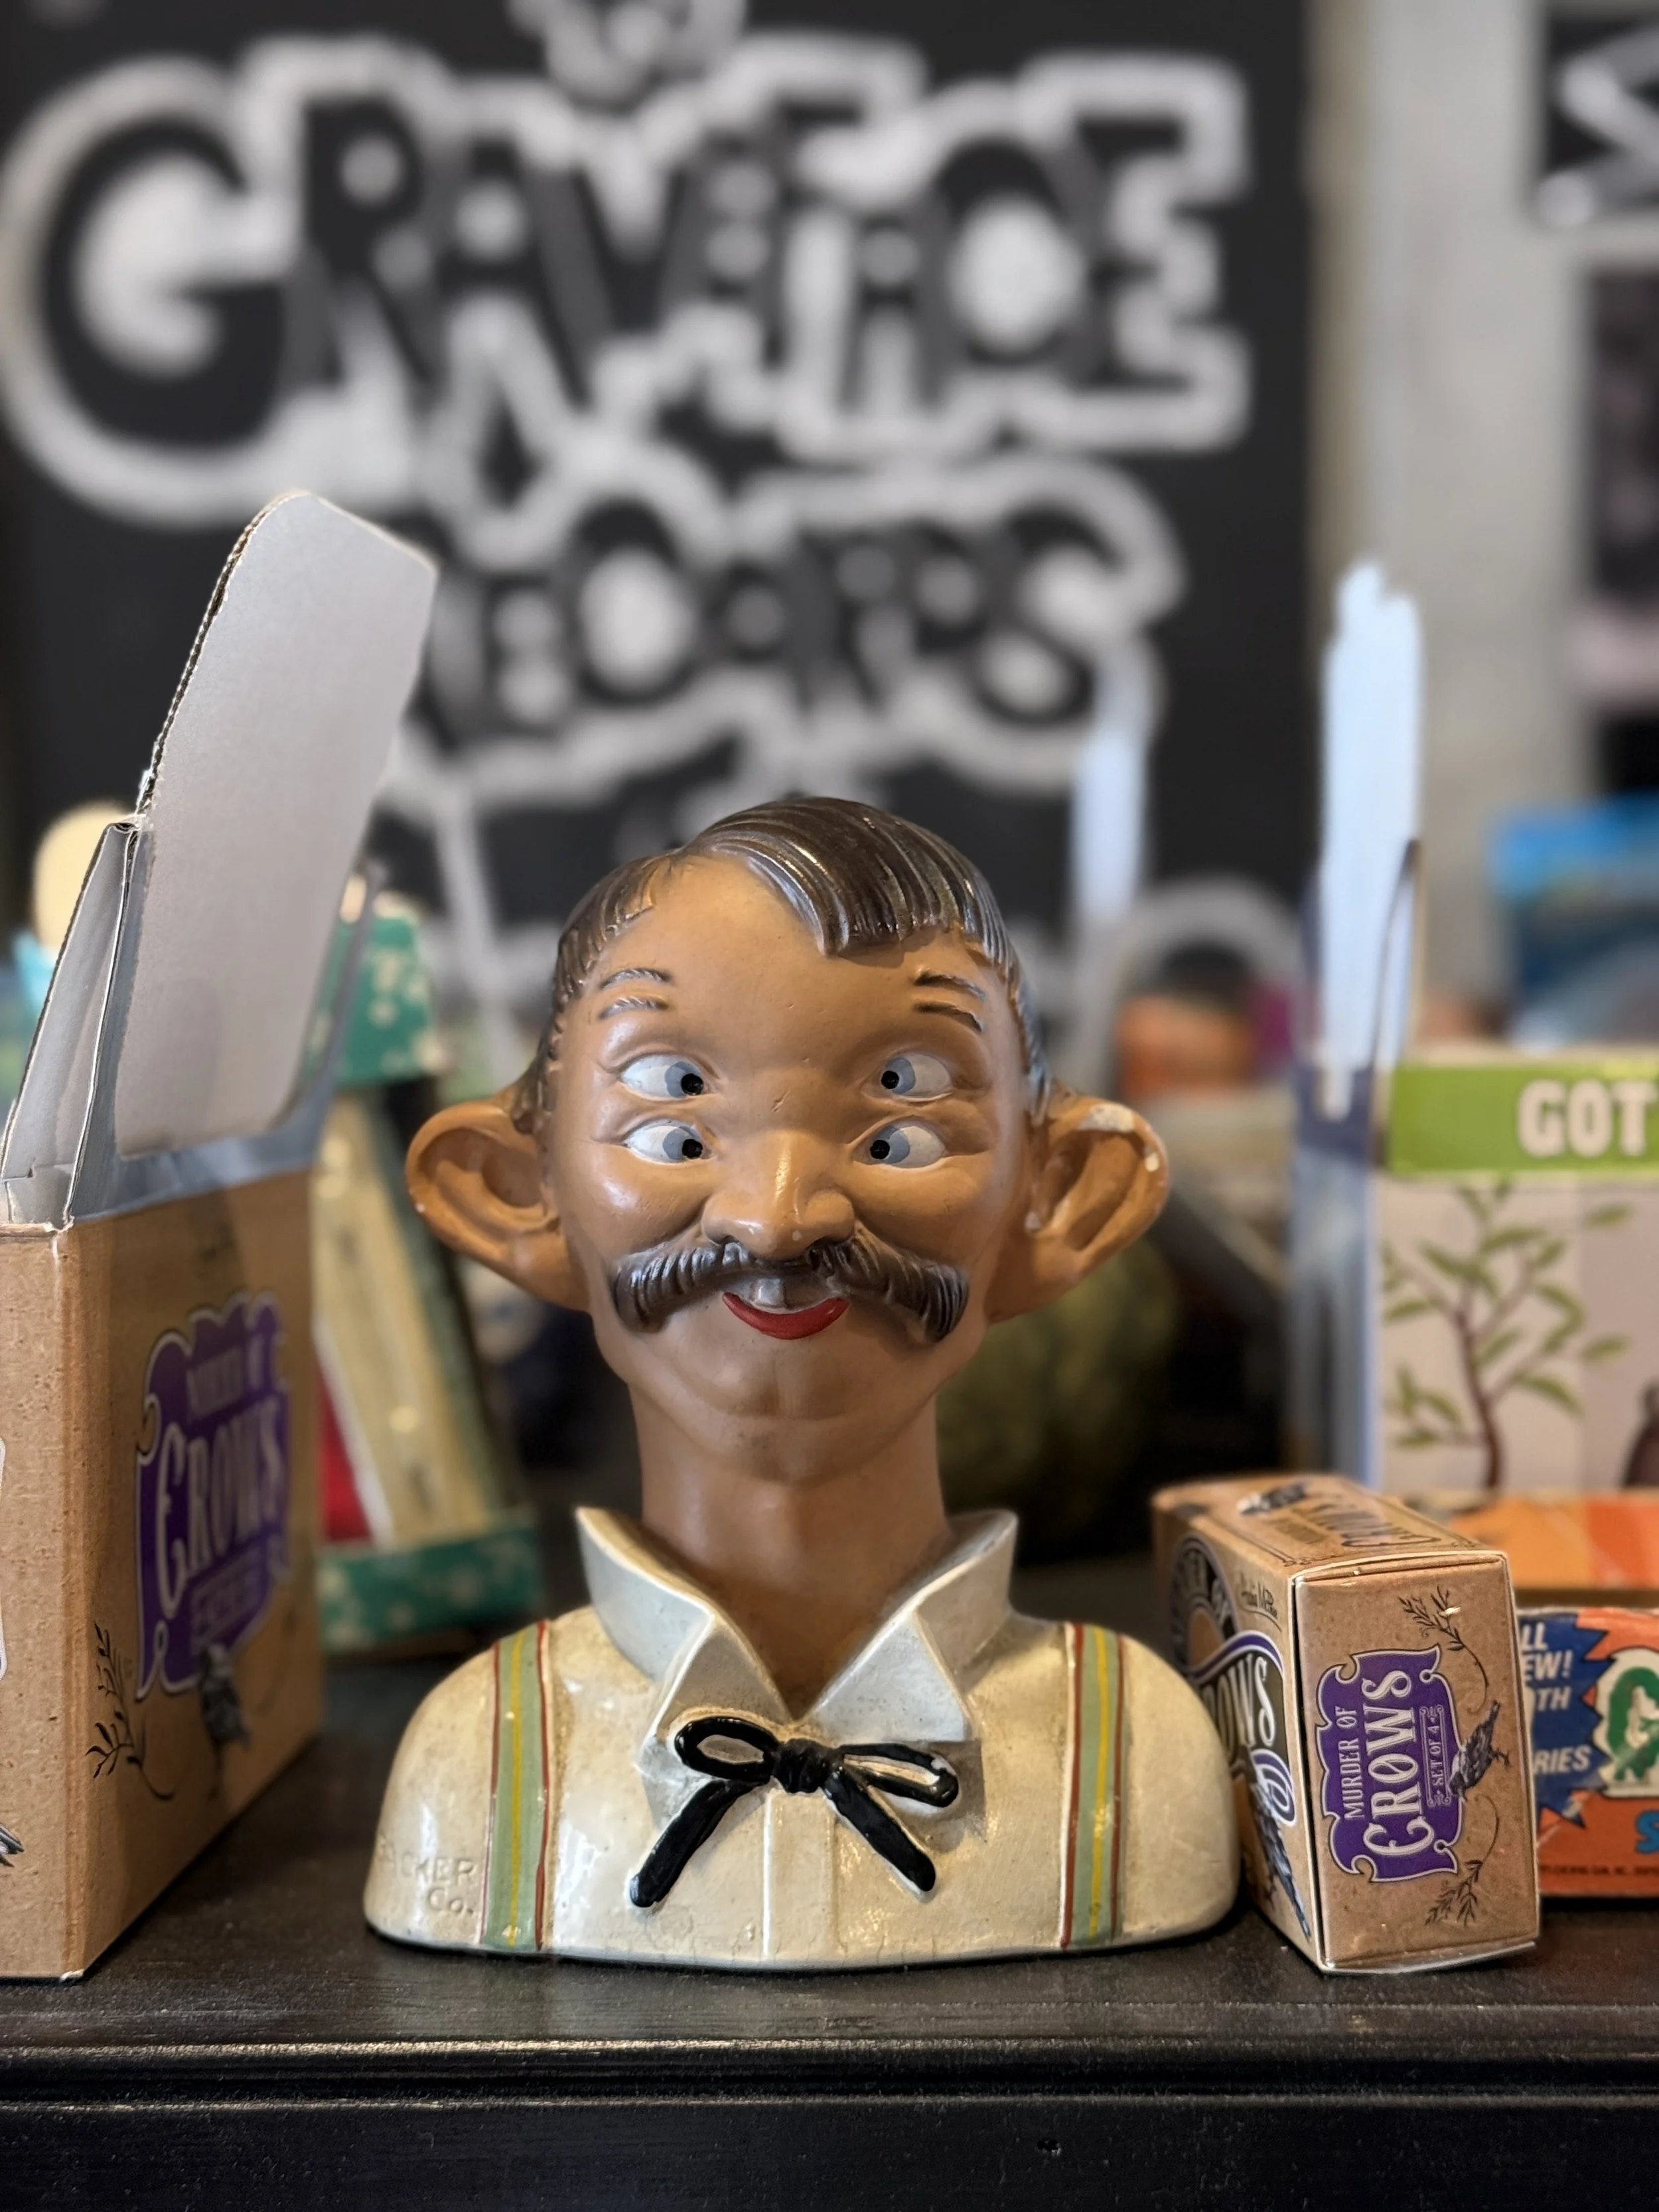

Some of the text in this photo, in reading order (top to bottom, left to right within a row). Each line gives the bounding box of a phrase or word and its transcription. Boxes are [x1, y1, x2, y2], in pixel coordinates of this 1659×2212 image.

[1517, 1078, 1659, 1157] GOT
[1521, 1622, 1548, 1651] LL
[1526, 1651, 1573, 1680] EW!
[1361, 1670, 1435, 1856] CROWS
[1431, 1760, 1445, 1787] SET
[1533, 1745, 1593, 1775] RIES
[1338, 1737, 1365, 1820] MURDER
[428, 1888, 474, 1913] Co.
